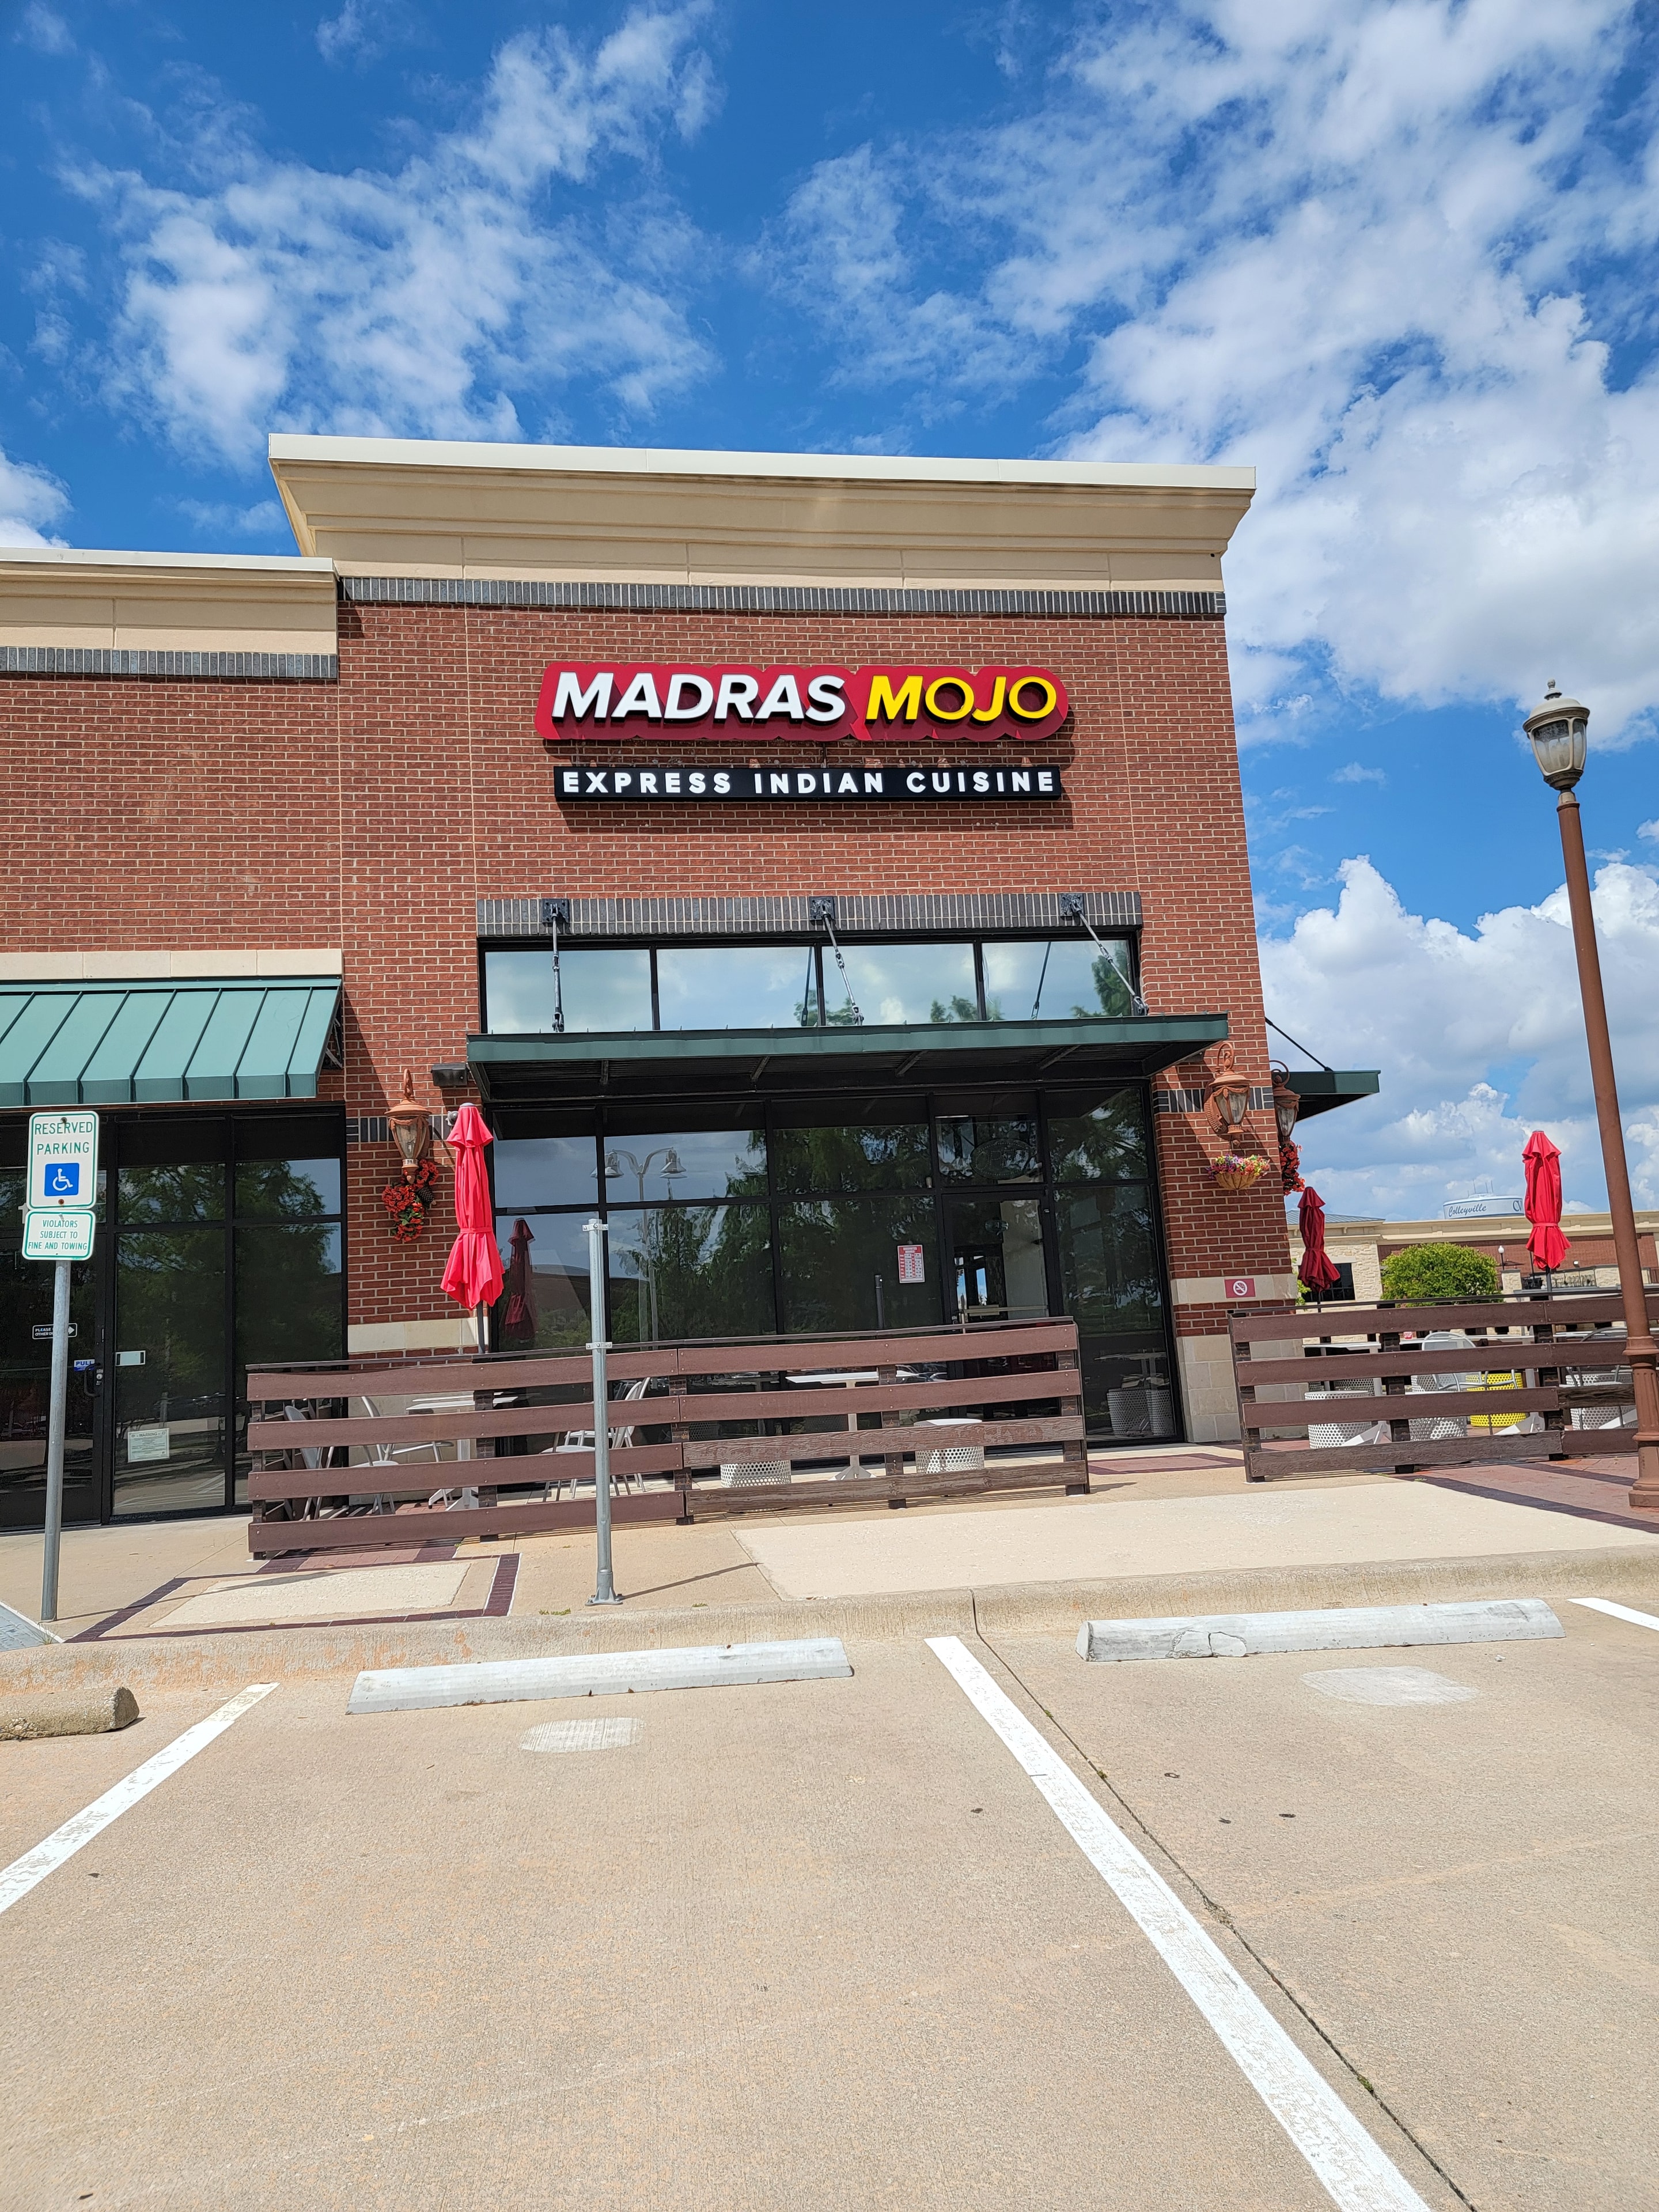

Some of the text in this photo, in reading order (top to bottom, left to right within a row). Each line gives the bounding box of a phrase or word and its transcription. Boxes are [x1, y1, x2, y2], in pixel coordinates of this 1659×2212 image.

[551, 671, 1058, 722] MADRAS MOJO
[563, 771, 1054, 794] EXPRESS INDIAN CUISINE
[35, 1122, 93, 1135] RESERVED
[37, 1142, 90, 1155] PARKING
[1448, 1203, 1486, 1217] Colleyville
[42, 1219, 78, 1228] VIOLATORS
[40, 1230, 67, 1238] SUBJECT
[28, 1241, 42, 1249] FINE
